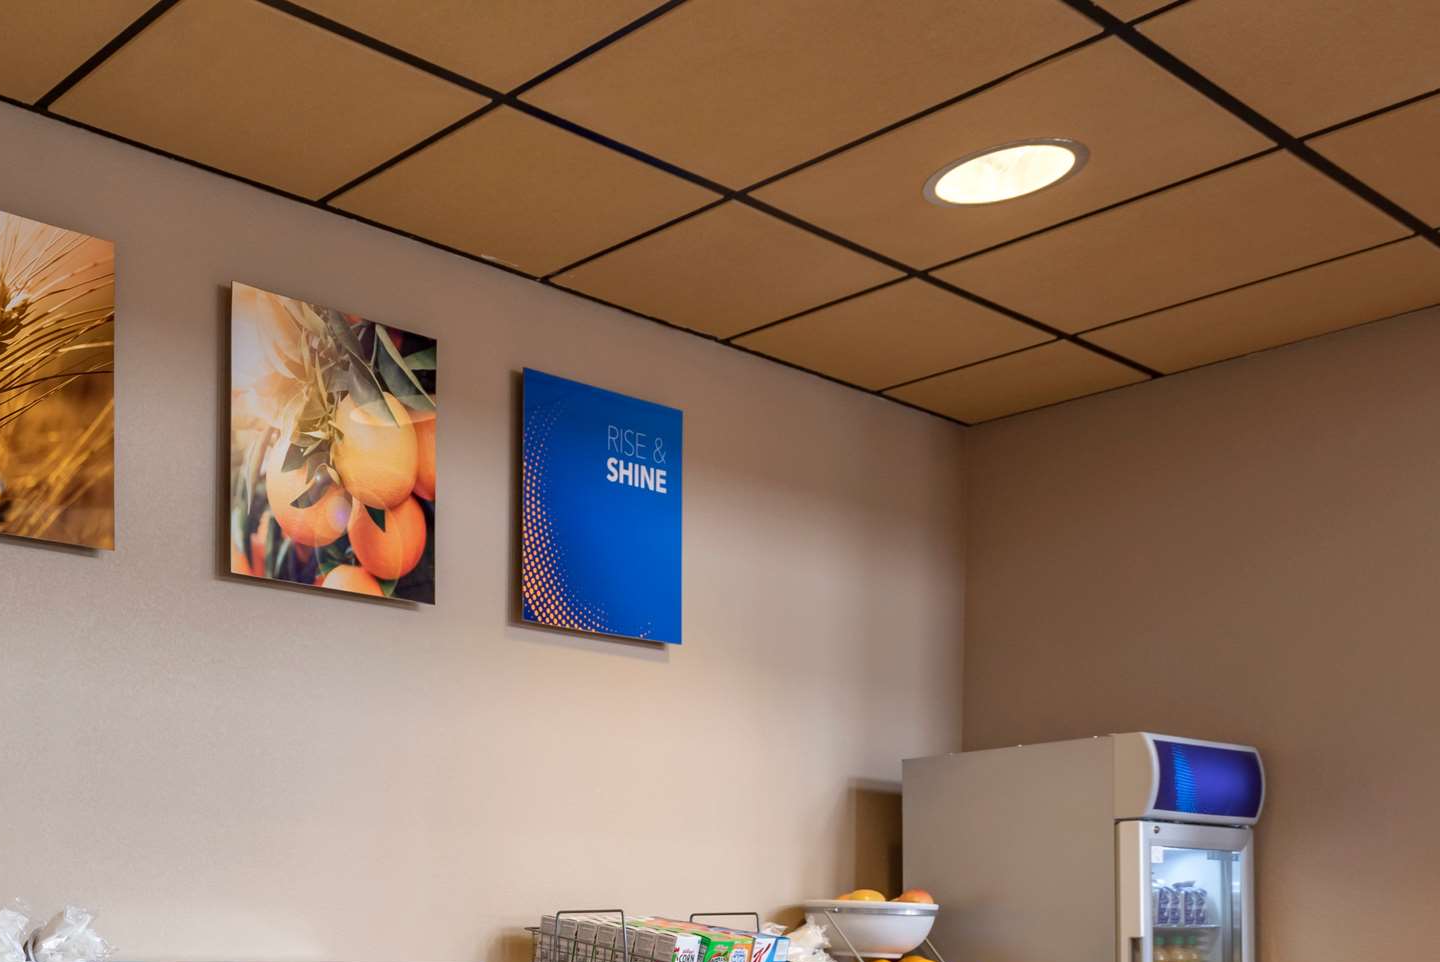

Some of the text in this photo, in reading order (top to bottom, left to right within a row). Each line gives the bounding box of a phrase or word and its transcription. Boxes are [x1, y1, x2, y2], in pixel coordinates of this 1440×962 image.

[607, 425, 666, 464] RISE &
[606, 457, 667, 494] SHINE
[678, 953, 695, 962] CORN
